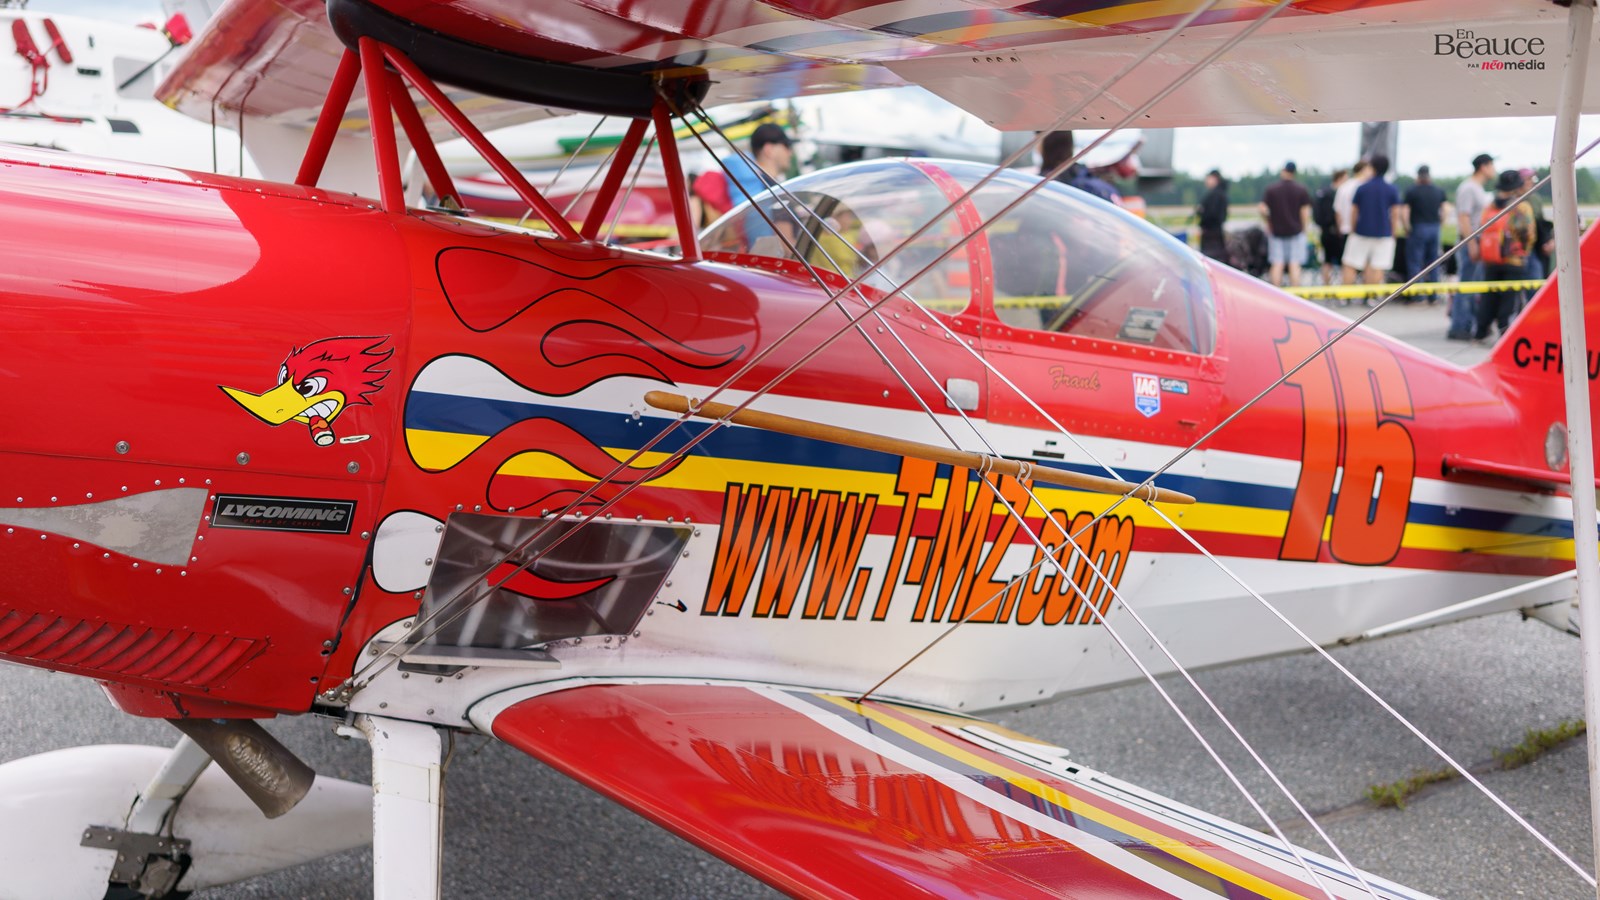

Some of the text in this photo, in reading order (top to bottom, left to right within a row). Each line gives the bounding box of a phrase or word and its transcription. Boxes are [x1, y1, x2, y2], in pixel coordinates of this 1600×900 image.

[1048, 364, 1101, 391] Frank
[1273, 316, 1416, 566] 16
[220, 503, 347, 521] LYCOMING
